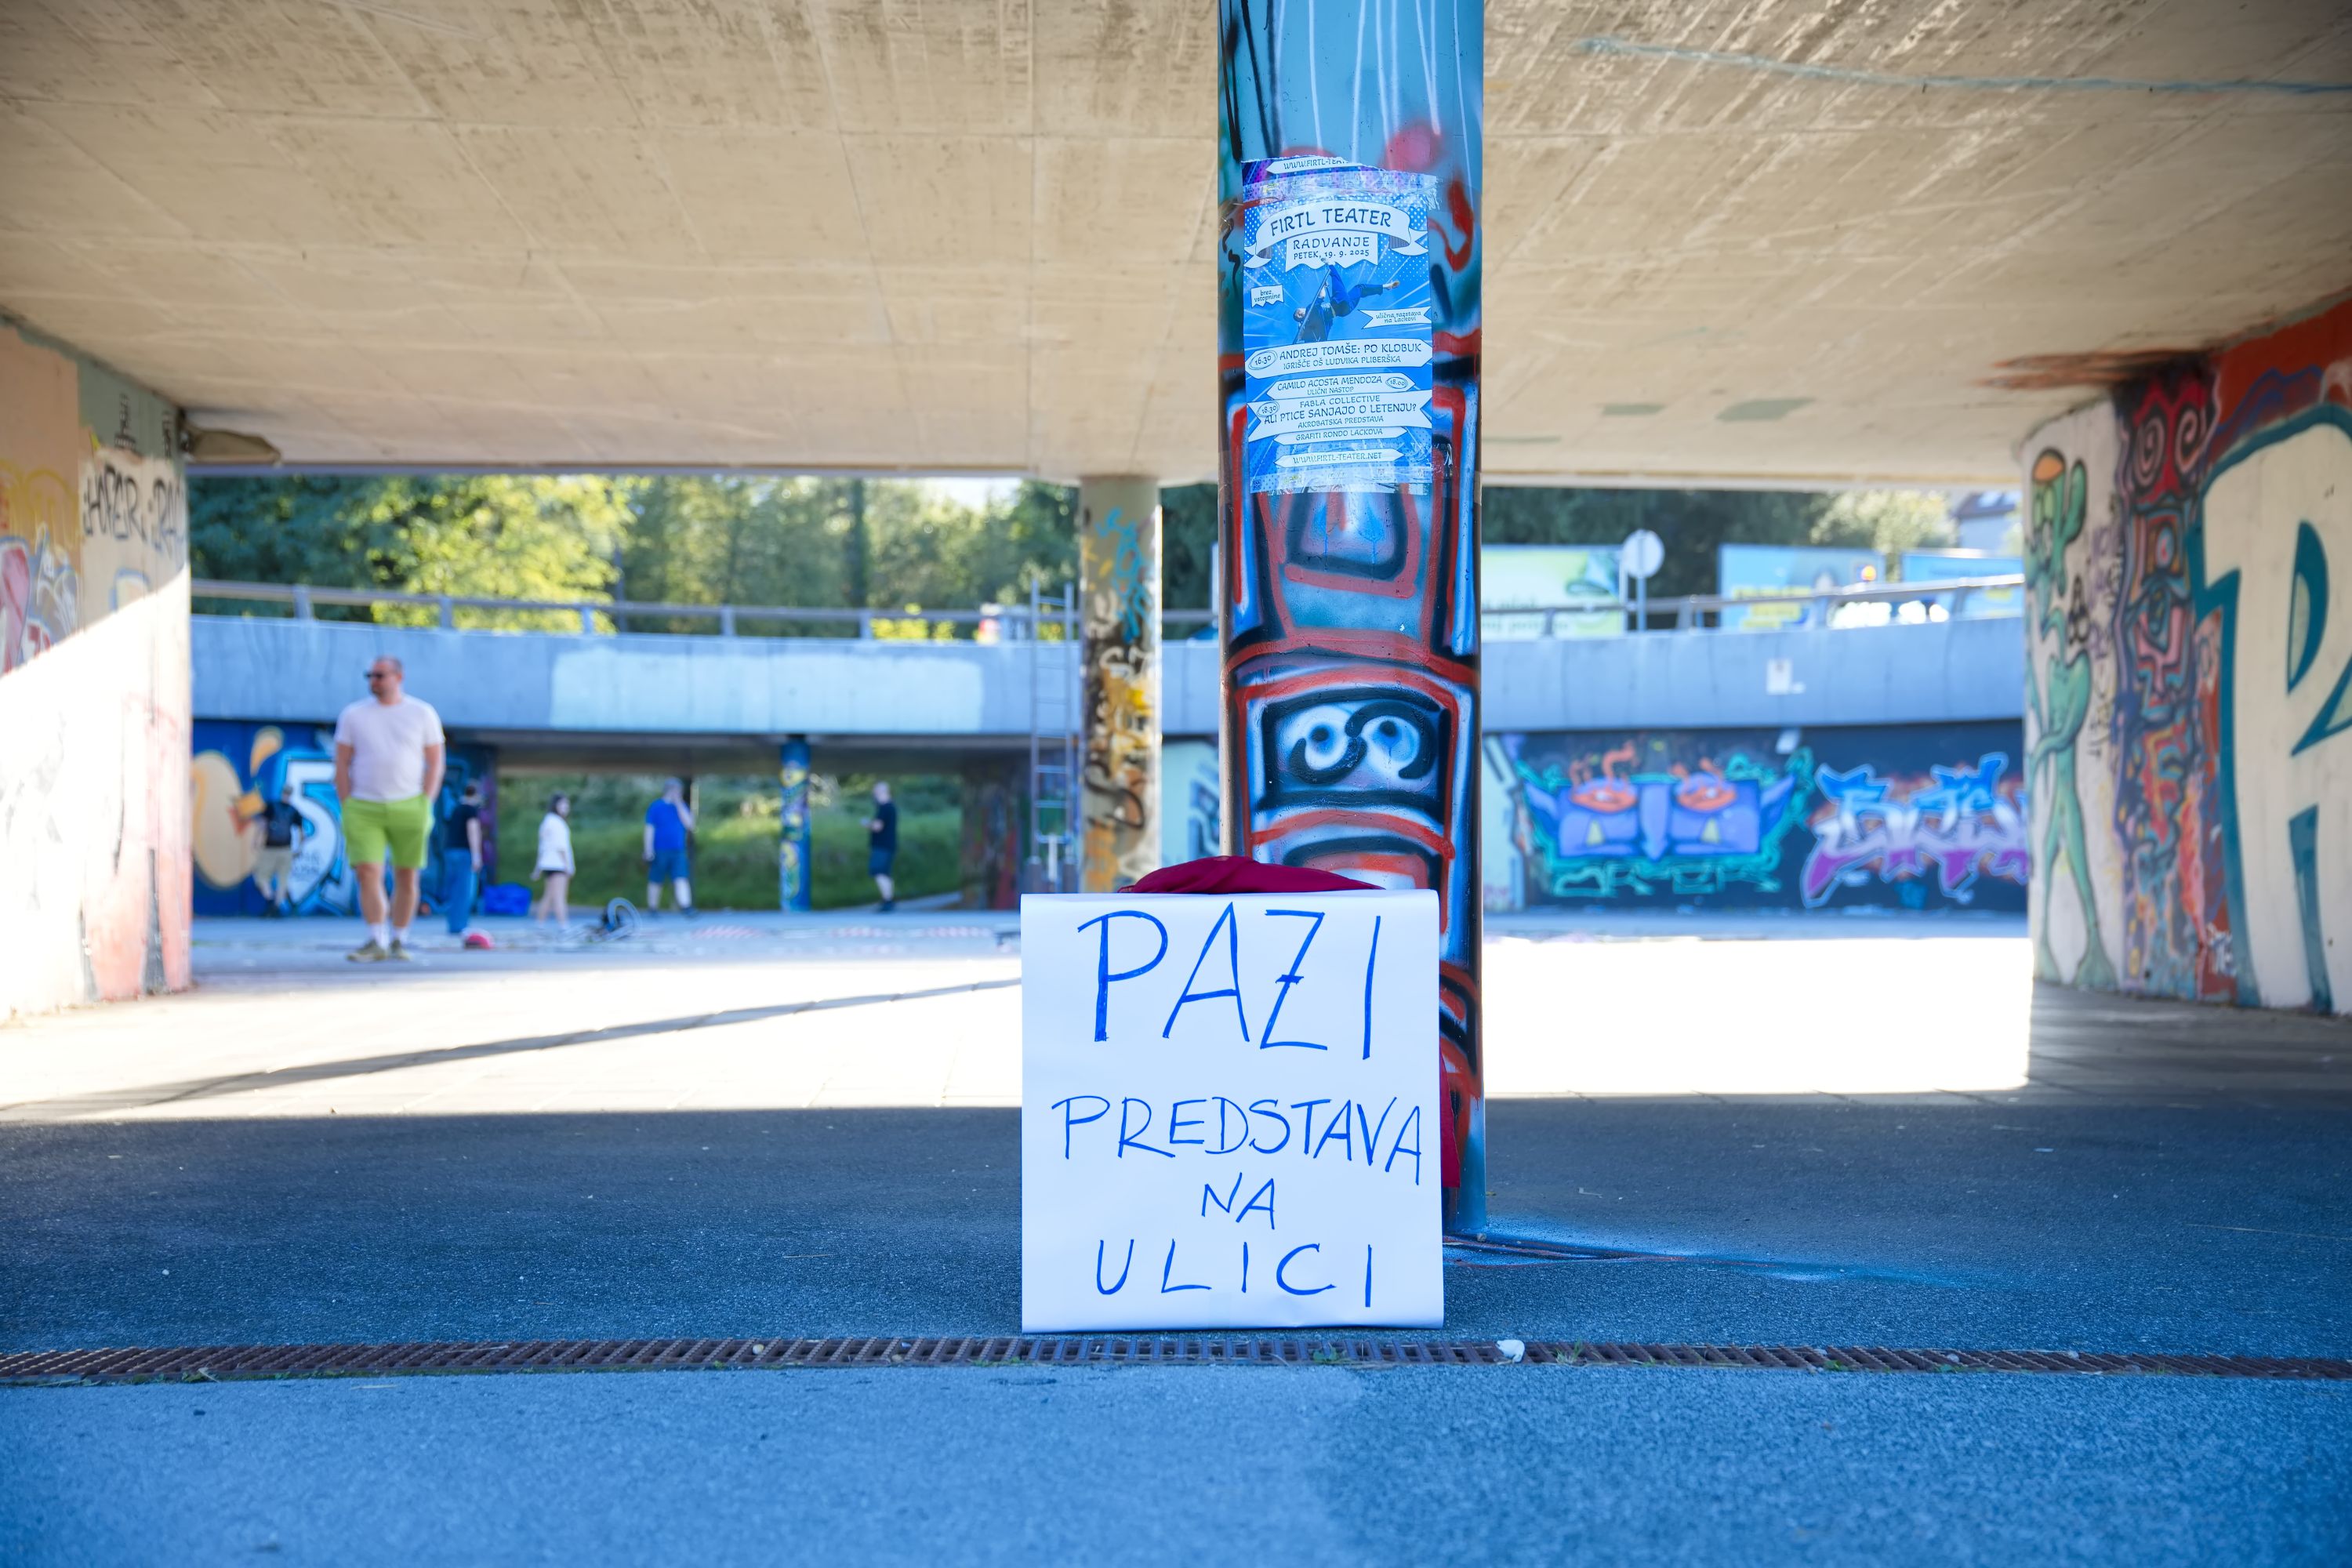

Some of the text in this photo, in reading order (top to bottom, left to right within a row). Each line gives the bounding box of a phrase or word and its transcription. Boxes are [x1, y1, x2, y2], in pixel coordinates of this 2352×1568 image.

[1270, 208, 1392, 237] FIRTL TEATER
[1294, 237, 1370, 249] RADVANJE
[1294, 251, 1322, 260] PETEK,
[1254, 293, 1281, 303] vstopnine
[1279, 343, 1421, 361] ANDREJ TOMŠE: PO KLOBUK
[1254, 355, 1272, 365] 16.30
[1283, 354, 1401, 369] IGRIŠČE OŠ LUDVIKA PLIBERŠKA
[1278, 376, 1382, 390] CAMILO ACOSTA MENDOZA
[1307, 387, 1327, 396] ULIČNI
[1300, 395, 1381, 408] FABLA COLLECTIVE
[1261, 405, 1277, 414] 18.30
[1265, 403, 1417, 424] ALI PTICE SANJAJO O LETENJU?
[1298, 418, 1343, 428] AKROBATSKA
[1296, 427, 1383, 440] GRAFITI RONDO LACKOVA
[1294, 452, 1382, 464] WWW.FIRTL-TEATER.NET
[1076, 902, 1382, 1060] PAZI
[1051, 1094, 1423, 1185] PREDSTAVA
[1200, 1171, 1276, 1230] NA
[1095, 1238, 1373, 1308] ULICI
